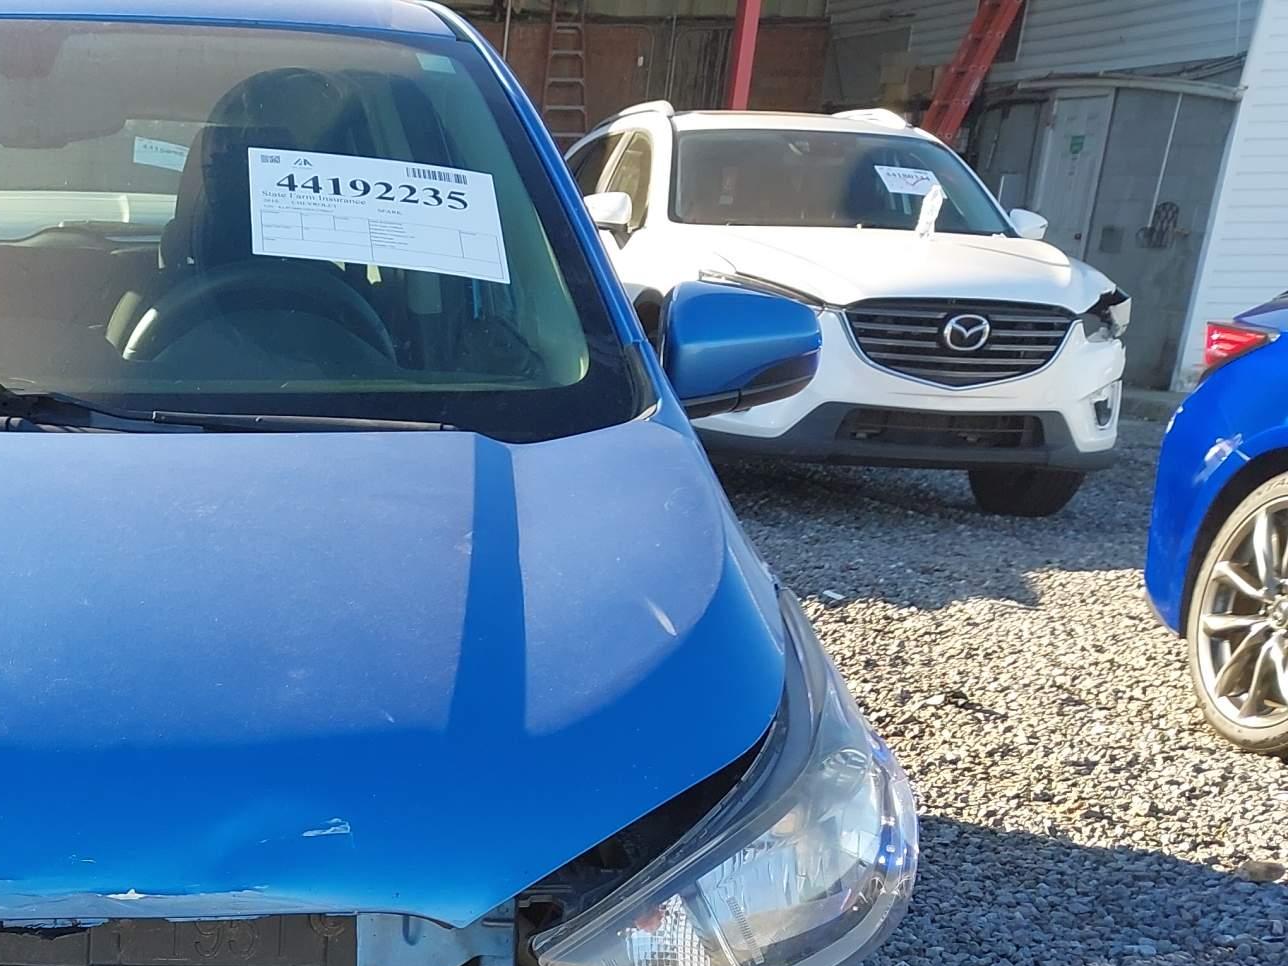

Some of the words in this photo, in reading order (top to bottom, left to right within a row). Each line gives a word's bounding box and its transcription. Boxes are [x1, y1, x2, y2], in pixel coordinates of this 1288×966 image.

[262, 190, 287, 198] State
[289, 192, 315, 201] Farm
[318, 194, 367, 205] Insurance
[276, 173, 469, 210] 44192235
